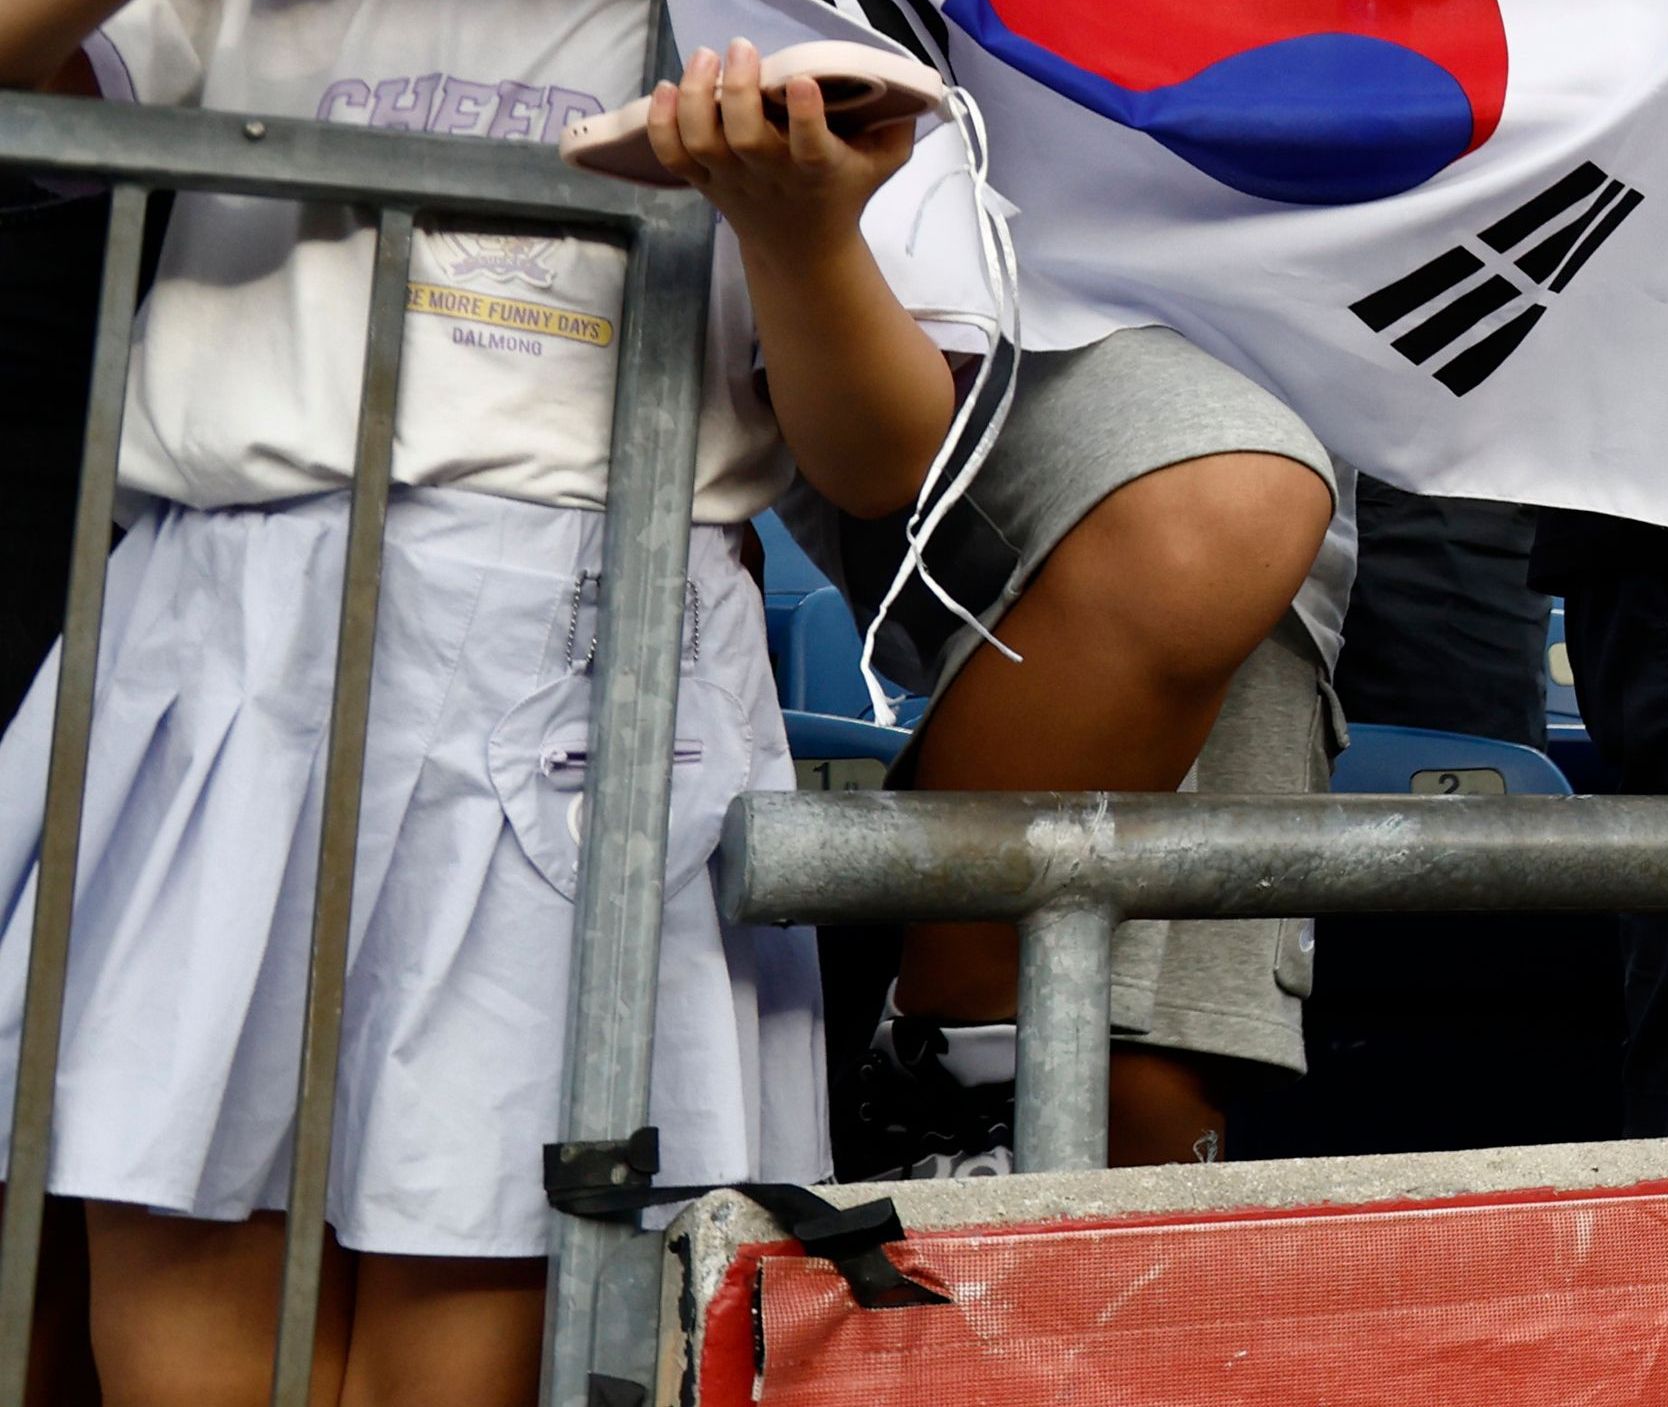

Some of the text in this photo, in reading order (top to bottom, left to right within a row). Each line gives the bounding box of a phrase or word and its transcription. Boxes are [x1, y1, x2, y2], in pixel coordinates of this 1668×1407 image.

[428, 290, 481, 316] MORE
[488, 301, 553, 328] FUNNY
[558, 315, 602, 341] DAYS
[1439, 773, 1460, 794] 2
